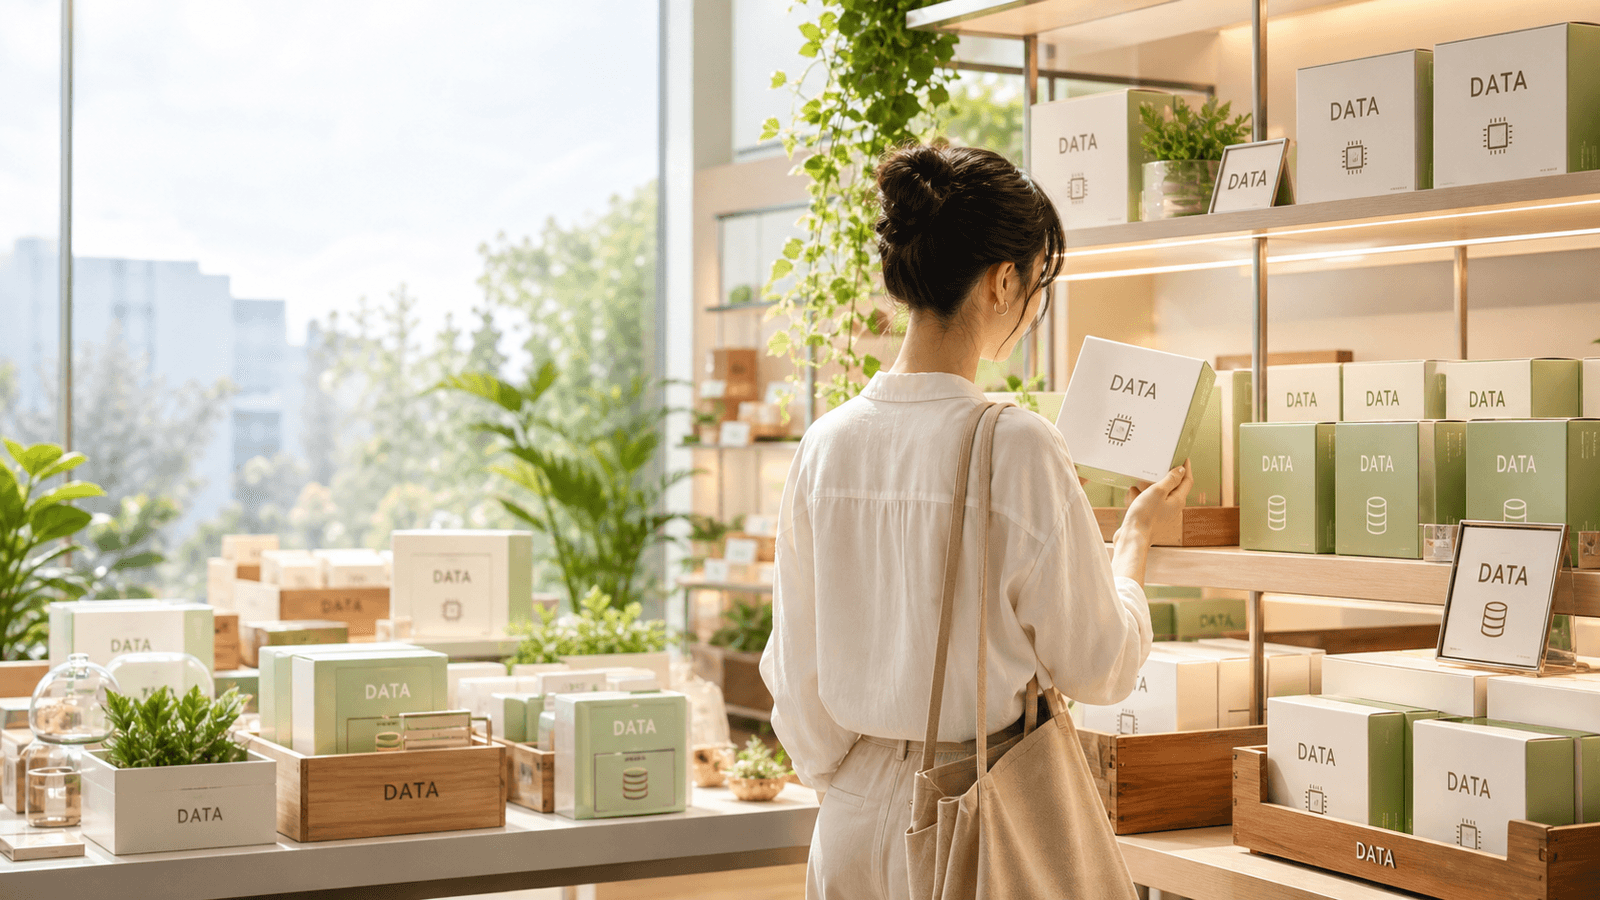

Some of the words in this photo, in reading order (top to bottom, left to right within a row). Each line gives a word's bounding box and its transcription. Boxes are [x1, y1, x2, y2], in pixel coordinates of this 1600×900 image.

[1471, 71, 1527, 97] DATA
[1331, 97, 1379, 121] DATA
[1059, 133, 1097, 154] DATA
[1228, 170, 1267, 190] DATA
[1110, 374, 1157, 400] DATA
[1287, 392, 1317, 408] DATA
[1366, 390, 1399, 406] DATA
[1470, 391, 1505, 407] DATA
[1263, 455, 1293, 471] DATA
[1361, 455, 1394, 472] DATA
[1497, 455, 1536, 473] DATA
[434, 570, 471, 583] DATA
[1478, 563, 1527, 586] DATA
[111, 638, 151, 652] DATA
[366, 683, 411, 699] DATA
[614, 719, 656, 736] DATA
[1298, 743, 1335, 766] DATA
[384, 781, 438, 800] DATA
[1448, 772, 1490, 799] DATA
[178, 807, 222, 823] DATA
[1356, 842, 1397, 869] DATA
